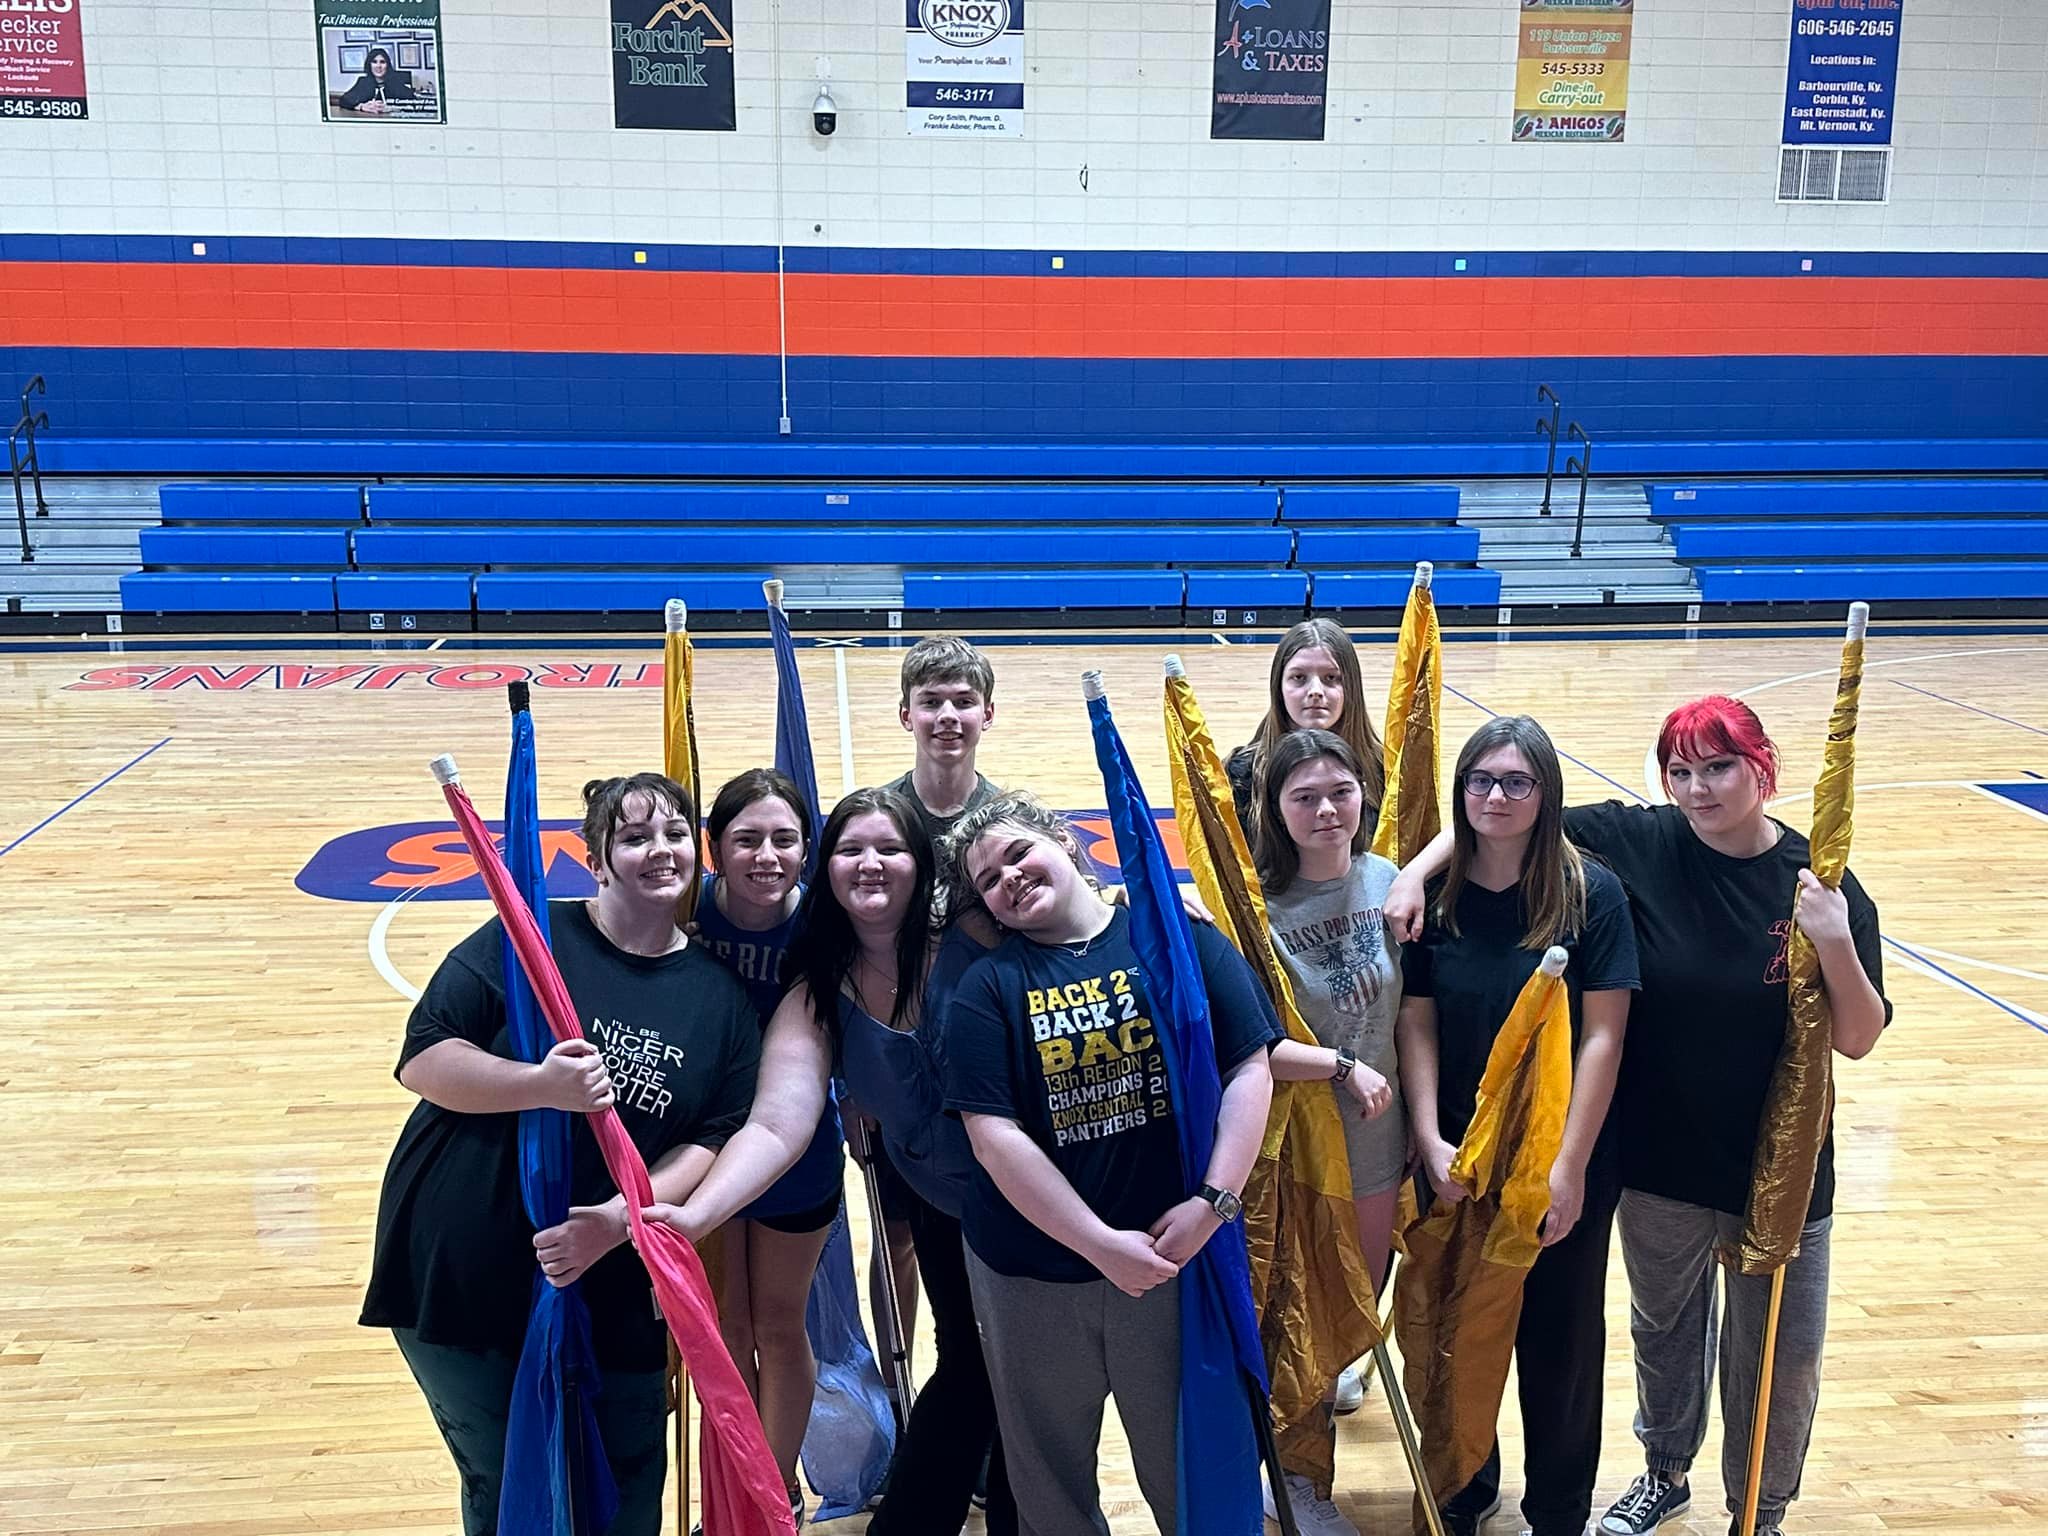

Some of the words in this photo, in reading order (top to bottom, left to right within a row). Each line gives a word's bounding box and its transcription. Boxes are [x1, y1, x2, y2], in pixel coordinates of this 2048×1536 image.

[319, 13, 378, 26] Tax/Business
[381, 14, 437, 28] Professional
[932, 4, 997, 25] KNOX
[1553, 29, 1588, 41] Union
[1589, 29, 1622, 42] Plaza
[1797, 19, 1894, 36] 606-546-2645
[612, 21, 706, 54] Forcht
[1542, 42, 1608, 54] Barbourville
[1241, 50, 1261, 71] &
[1264, 51, 1324, 72] TAXES
[1810, 54, 1861, 65] Locations
[628, 54, 708, 86] Bank
[1541, 62, 1605, 75] 545-5333
[935, 88, 994, 101] 546-3171
[1553, 81, 1594, 92] Dine-in
[1799, 81, 1866, 92] Barbourville,
[1868, 82, 1883, 92] Ky.
[1539, 91, 1603, 106] Carry-out
[1813, 94, 1850, 104] Corbin,
[1852, 95, 1866, 105] Ky.
[928, 114, 944, 122] Cory
[1791, 107, 1813, 117] East
[1815, 108, 1869, 118] Bernstadt,
[1871, 109, 1886, 119] Ky.
[1535, 117, 1543, 129] 2
[1549, 117, 1605, 129] AMIGOS
[1800, 121, 1816, 130] Mt.
[1818, 121, 1858, 131] Vernon,
[1860, 122, 1875, 132] Ky.
[1279, 924, 1322, 956] BASS
[1323, 915, 1350, 941] PRO
[1027, 977, 1107, 1016] BACK
[1109, 969, 1132, 995] 2
[1030, 1001, 1115, 1043] BACK
[1117, 992, 1139, 1021] 2
[611, 1019, 634, 1035] I'LL
[639, 1028, 661, 1040] BE
[592, 1017, 685, 1068] NICER
[605, 1042, 661, 1067] WHEN
[1083, 1053, 1143, 1085] REGION
[1048, 1072, 1144, 1112] CHAMPIONS
[1051, 1103, 1087, 1130] KNOX
[1089, 1090, 1145, 1120] CENTRAL
[1055, 1108, 1147, 1147] PANTHERS
